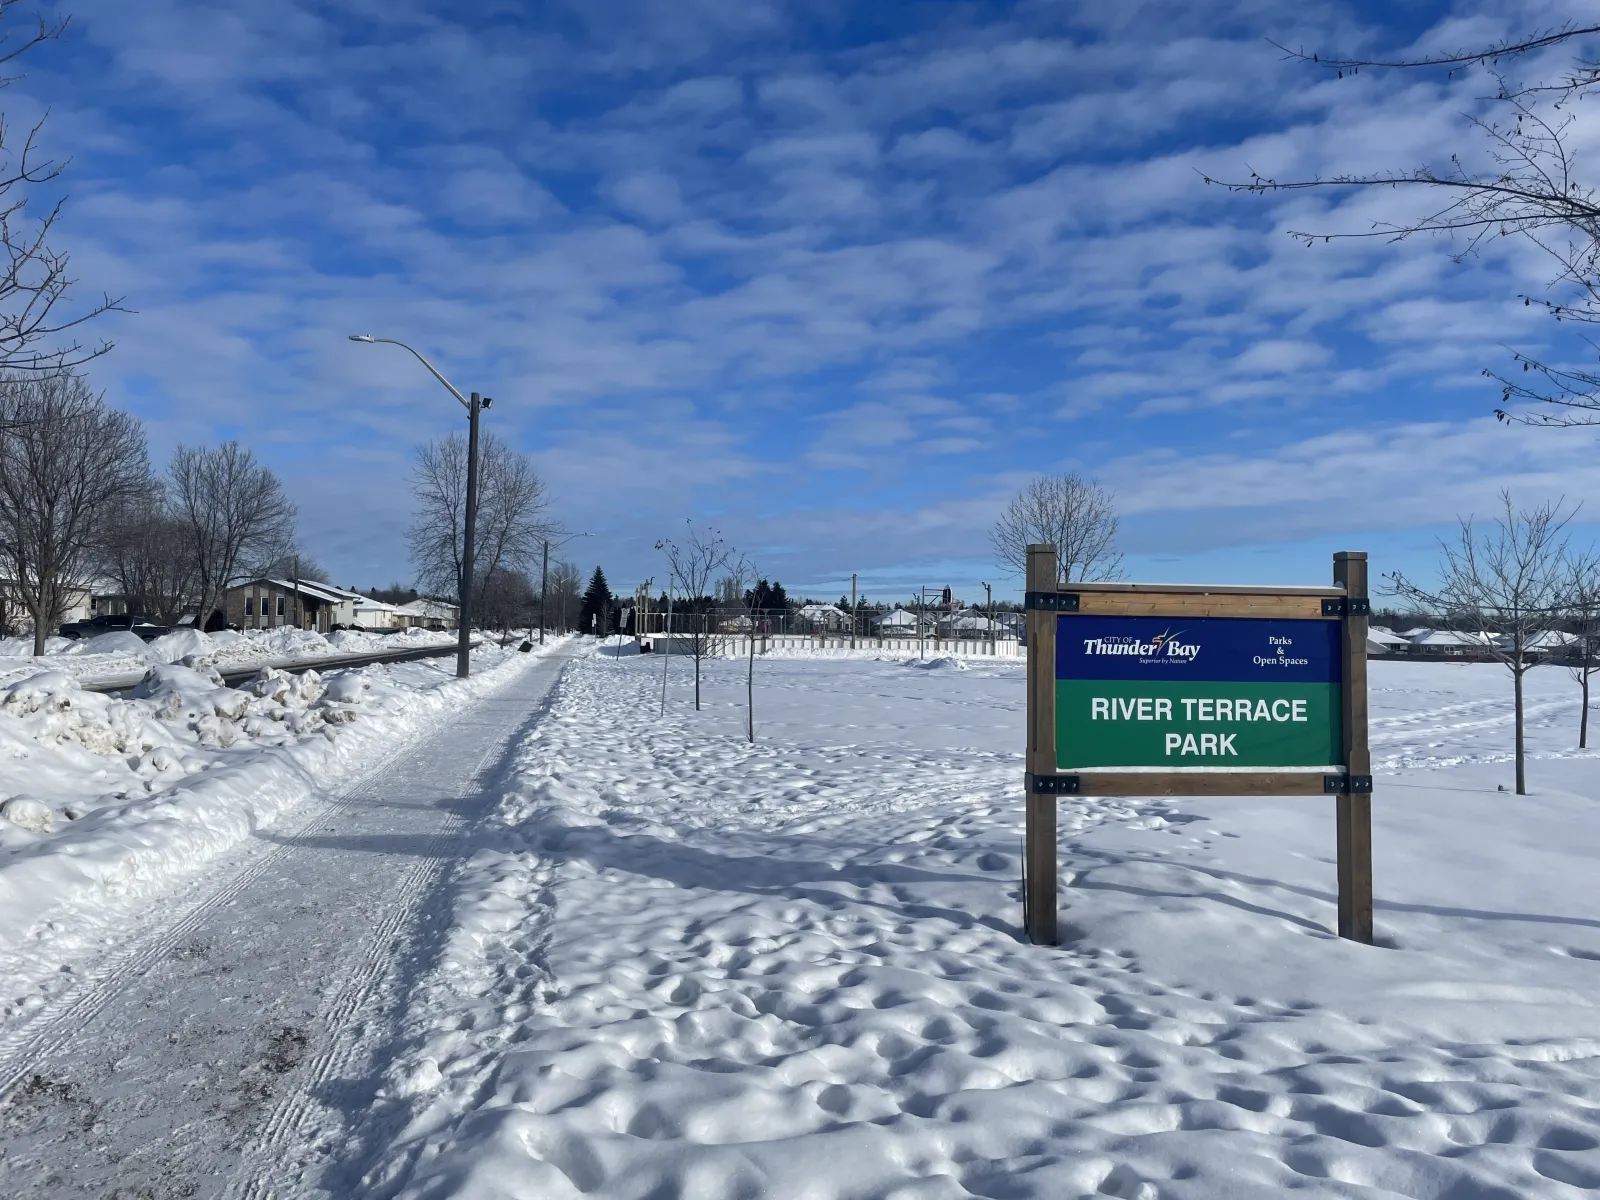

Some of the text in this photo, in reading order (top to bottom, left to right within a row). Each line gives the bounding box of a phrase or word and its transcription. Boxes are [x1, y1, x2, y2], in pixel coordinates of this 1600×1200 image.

[1269, 636, 1292, 645] Parks
[1084, 638, 1201, 661] Thunder Bay
[1277, 646, 1284, 654] &
[1253, 656, 1308, 667] Open Spaces
[1091, 697, 1308, 722] RIVER TERRACE
[1165, 733, 1238, 756] PARK
